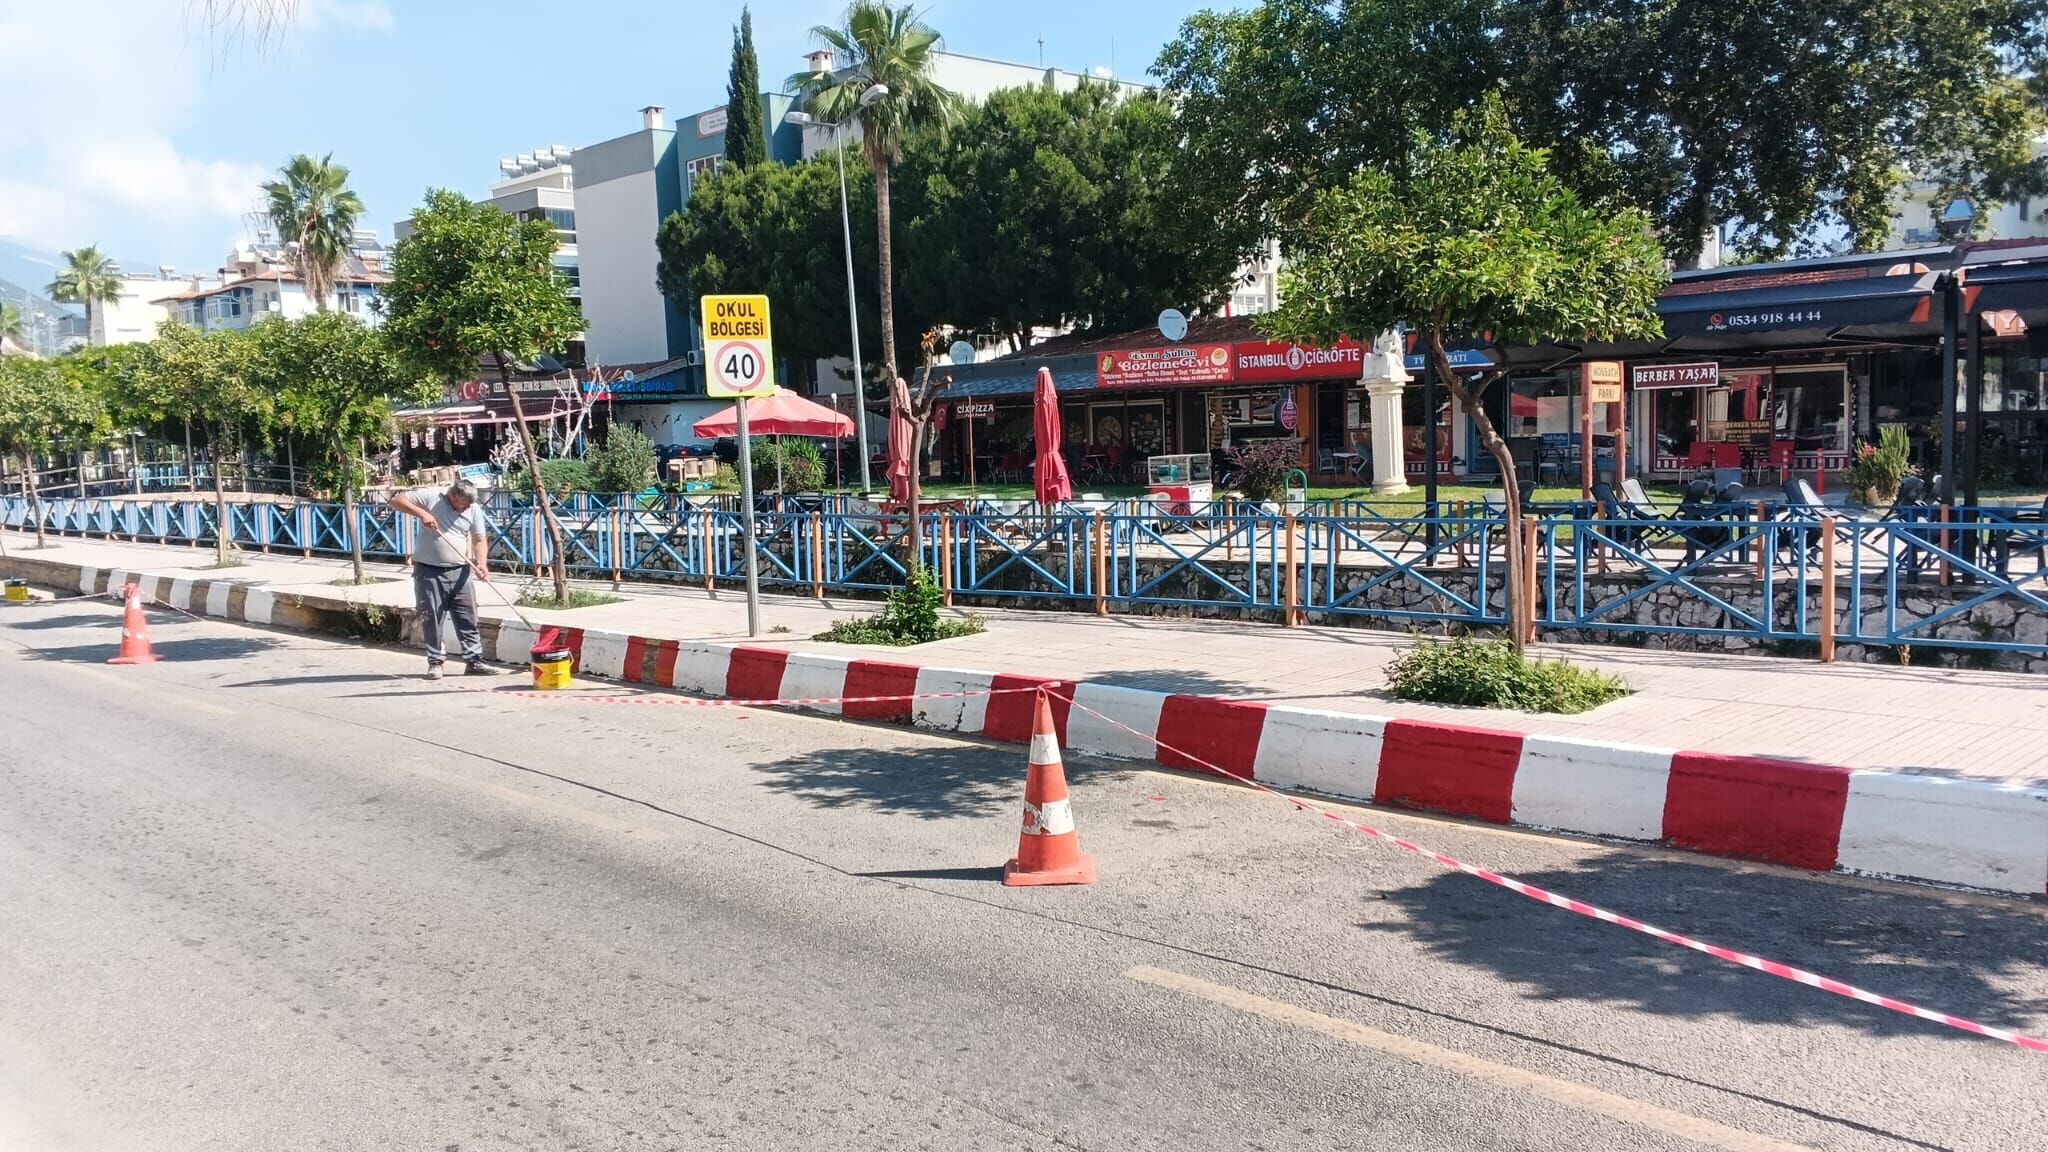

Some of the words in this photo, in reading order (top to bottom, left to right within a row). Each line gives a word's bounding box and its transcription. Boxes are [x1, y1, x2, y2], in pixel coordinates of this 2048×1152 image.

[716, 301, 756, 317] OKUL
[1729, 315, 1758, 326] 0534
[1761, 312, 1783, 324] 918
[1787, 311, 1802, 322] 44
[1805, 310, 1821, 321] 44
[710, 318, 764, 336] BÖLGESİ
[725, 353, 755, 379] 40
[1239, 353, 1286, 368] İSTANBUL
[1636, 369, 1675, 383] BERBER
[1678, 367, 1716, 381] YAŞAR
